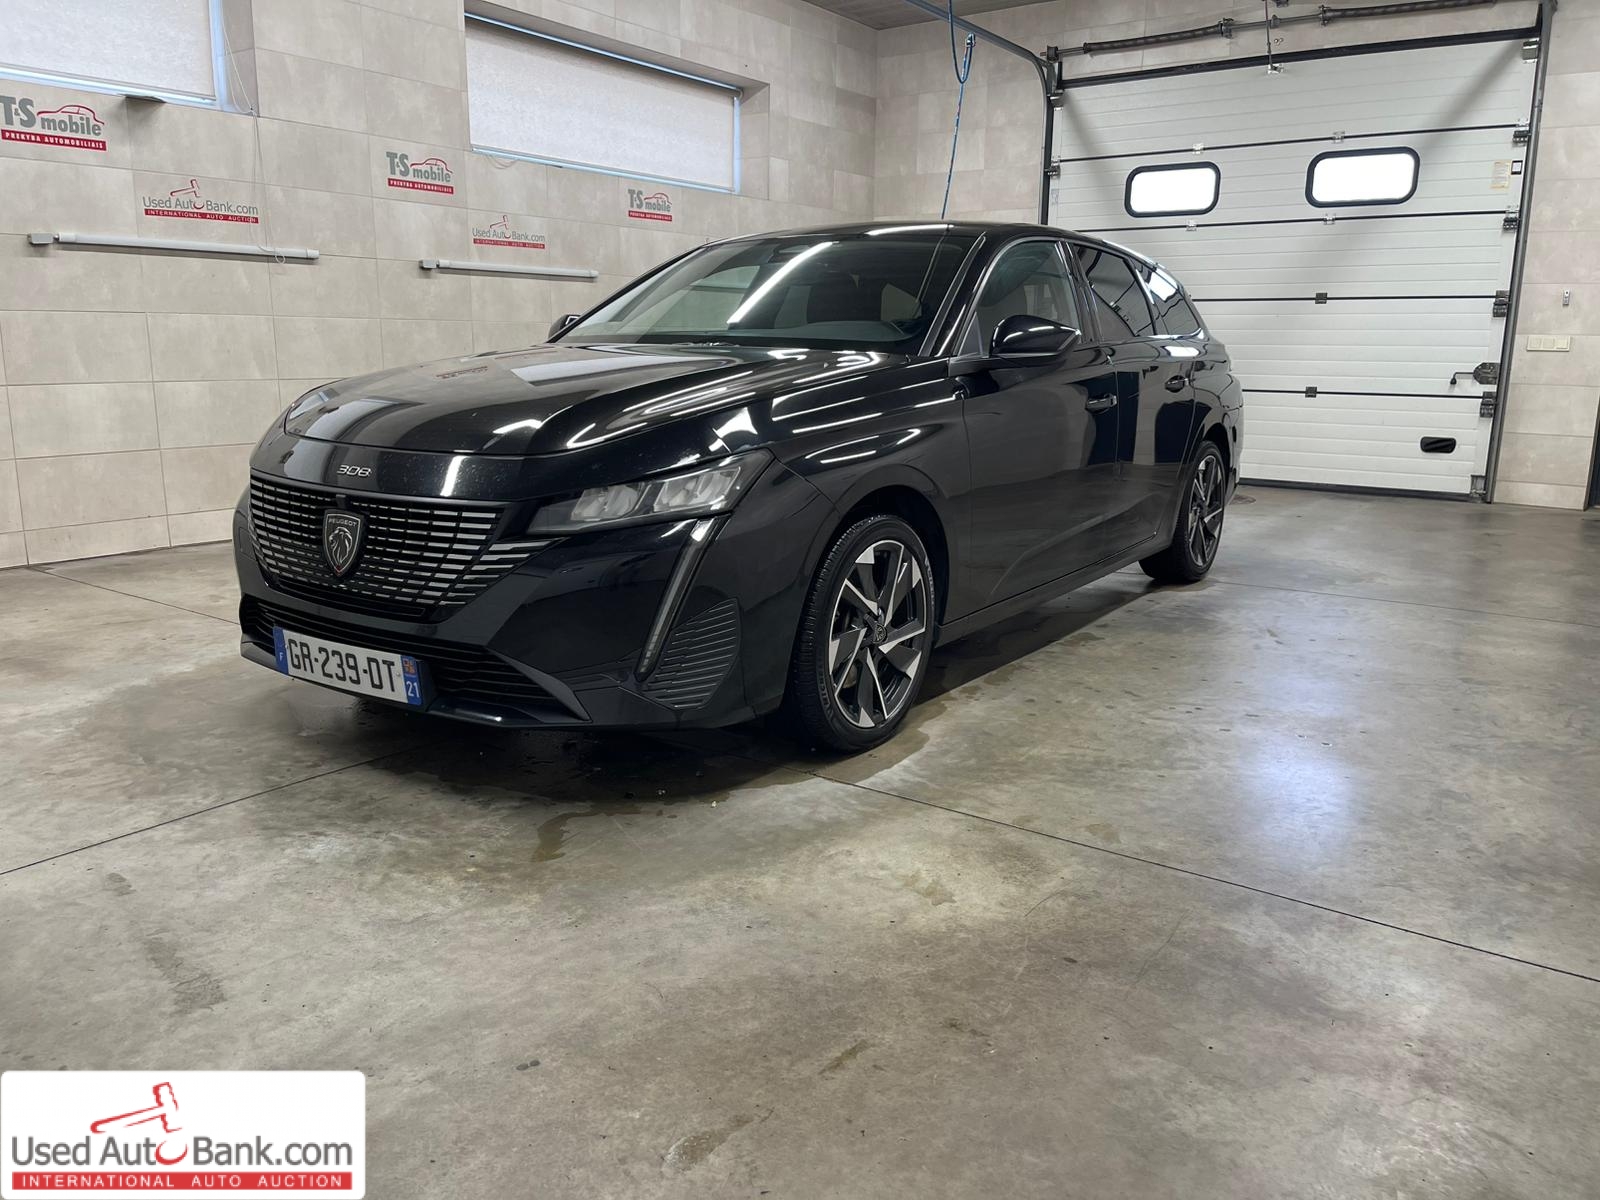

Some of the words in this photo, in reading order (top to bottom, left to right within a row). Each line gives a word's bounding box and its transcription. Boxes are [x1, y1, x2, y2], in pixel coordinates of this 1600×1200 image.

[41, 115, 102, 136] mobile
[412, 166, 451, 182] mobile
[143, 196, 171, 208] Used
[645, 199, 671, 212] mobile
[147, 209, 201, 218] INTERNATIONAL
[228, 215, 257, 223] AUCTION
[472, 227, 490, 238] Used
[336, 464, 371, 477] 308
[328, 518, 357, 527] PEUGEOT
[279, 652, 284, 662] F
[288, 638, 395, 692] GR-239-DT
[406, 681, 420, 698] 21
